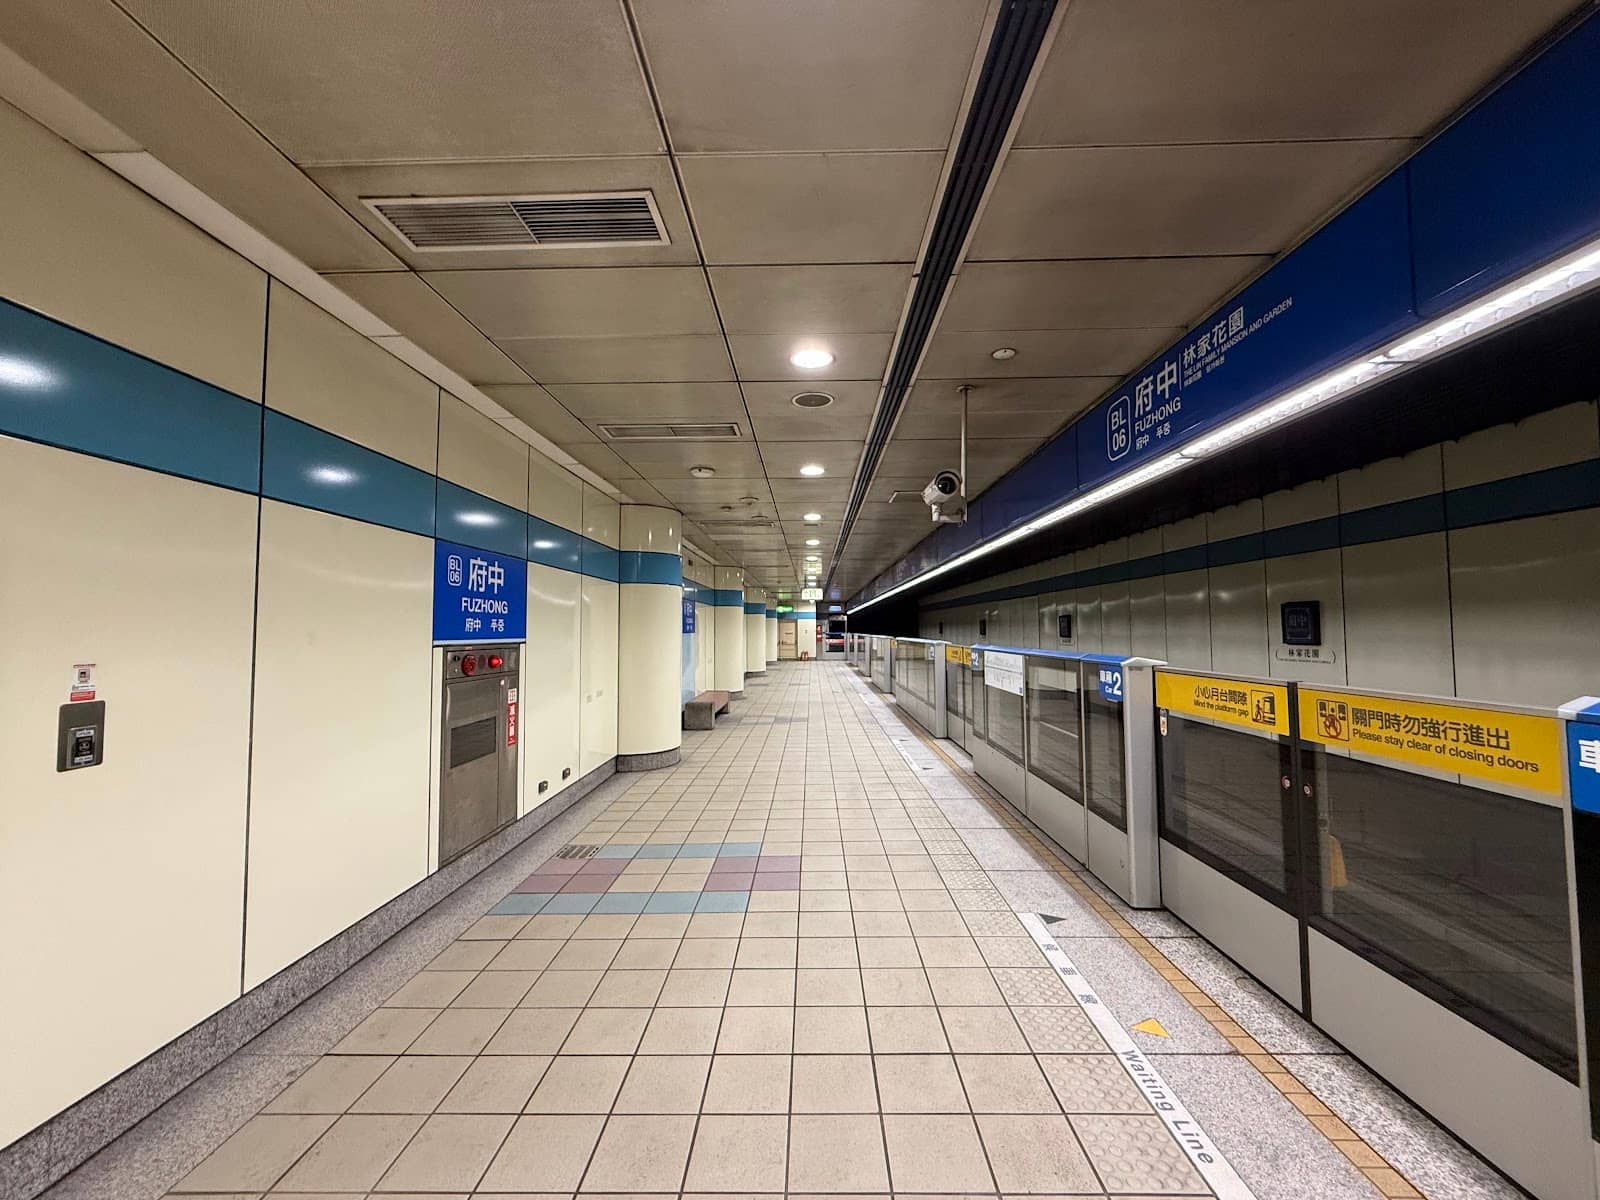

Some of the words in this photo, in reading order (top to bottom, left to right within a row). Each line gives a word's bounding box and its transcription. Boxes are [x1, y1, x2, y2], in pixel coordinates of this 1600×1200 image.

[1249, 318, 1263, 335] AND
[1263, 296, 1293, 324] GARDEN
[1183, 306, 1244, 368] 林家花園
[1135, 361, 1177, 418] 府中
[1111, 407, 1127, 431] BL
[1134, 397, 1181, 435] FUZHONG
[1112, 429, 1127, 451] 06
[449, 558, 461, 571] BL
[449, 571, 460, 583] 06
[468, 557, 504, 594] 府中
[461, 597, 509, 614] FUZHONG
[465, 617, 481, 632] 府中
[1113, 671, 1122, 696] 2
[1238, 709, 1249, 718] gap
[1352, 707, 1510, 751] 關門時勿強行進出
[1352, 728, 1382, 743] Please
[1384, 735, 1405, 749] stay
[1407, 740, 1433, 752] clear
[1435, 744, 1446, 755] of
[1448, 746, 1494, 767] closing
[1497, 754, 1539, 773] doors
[1120, 1050, 1175, 1112] Waiting
[1172, 1119, 1214, 1165] Line
